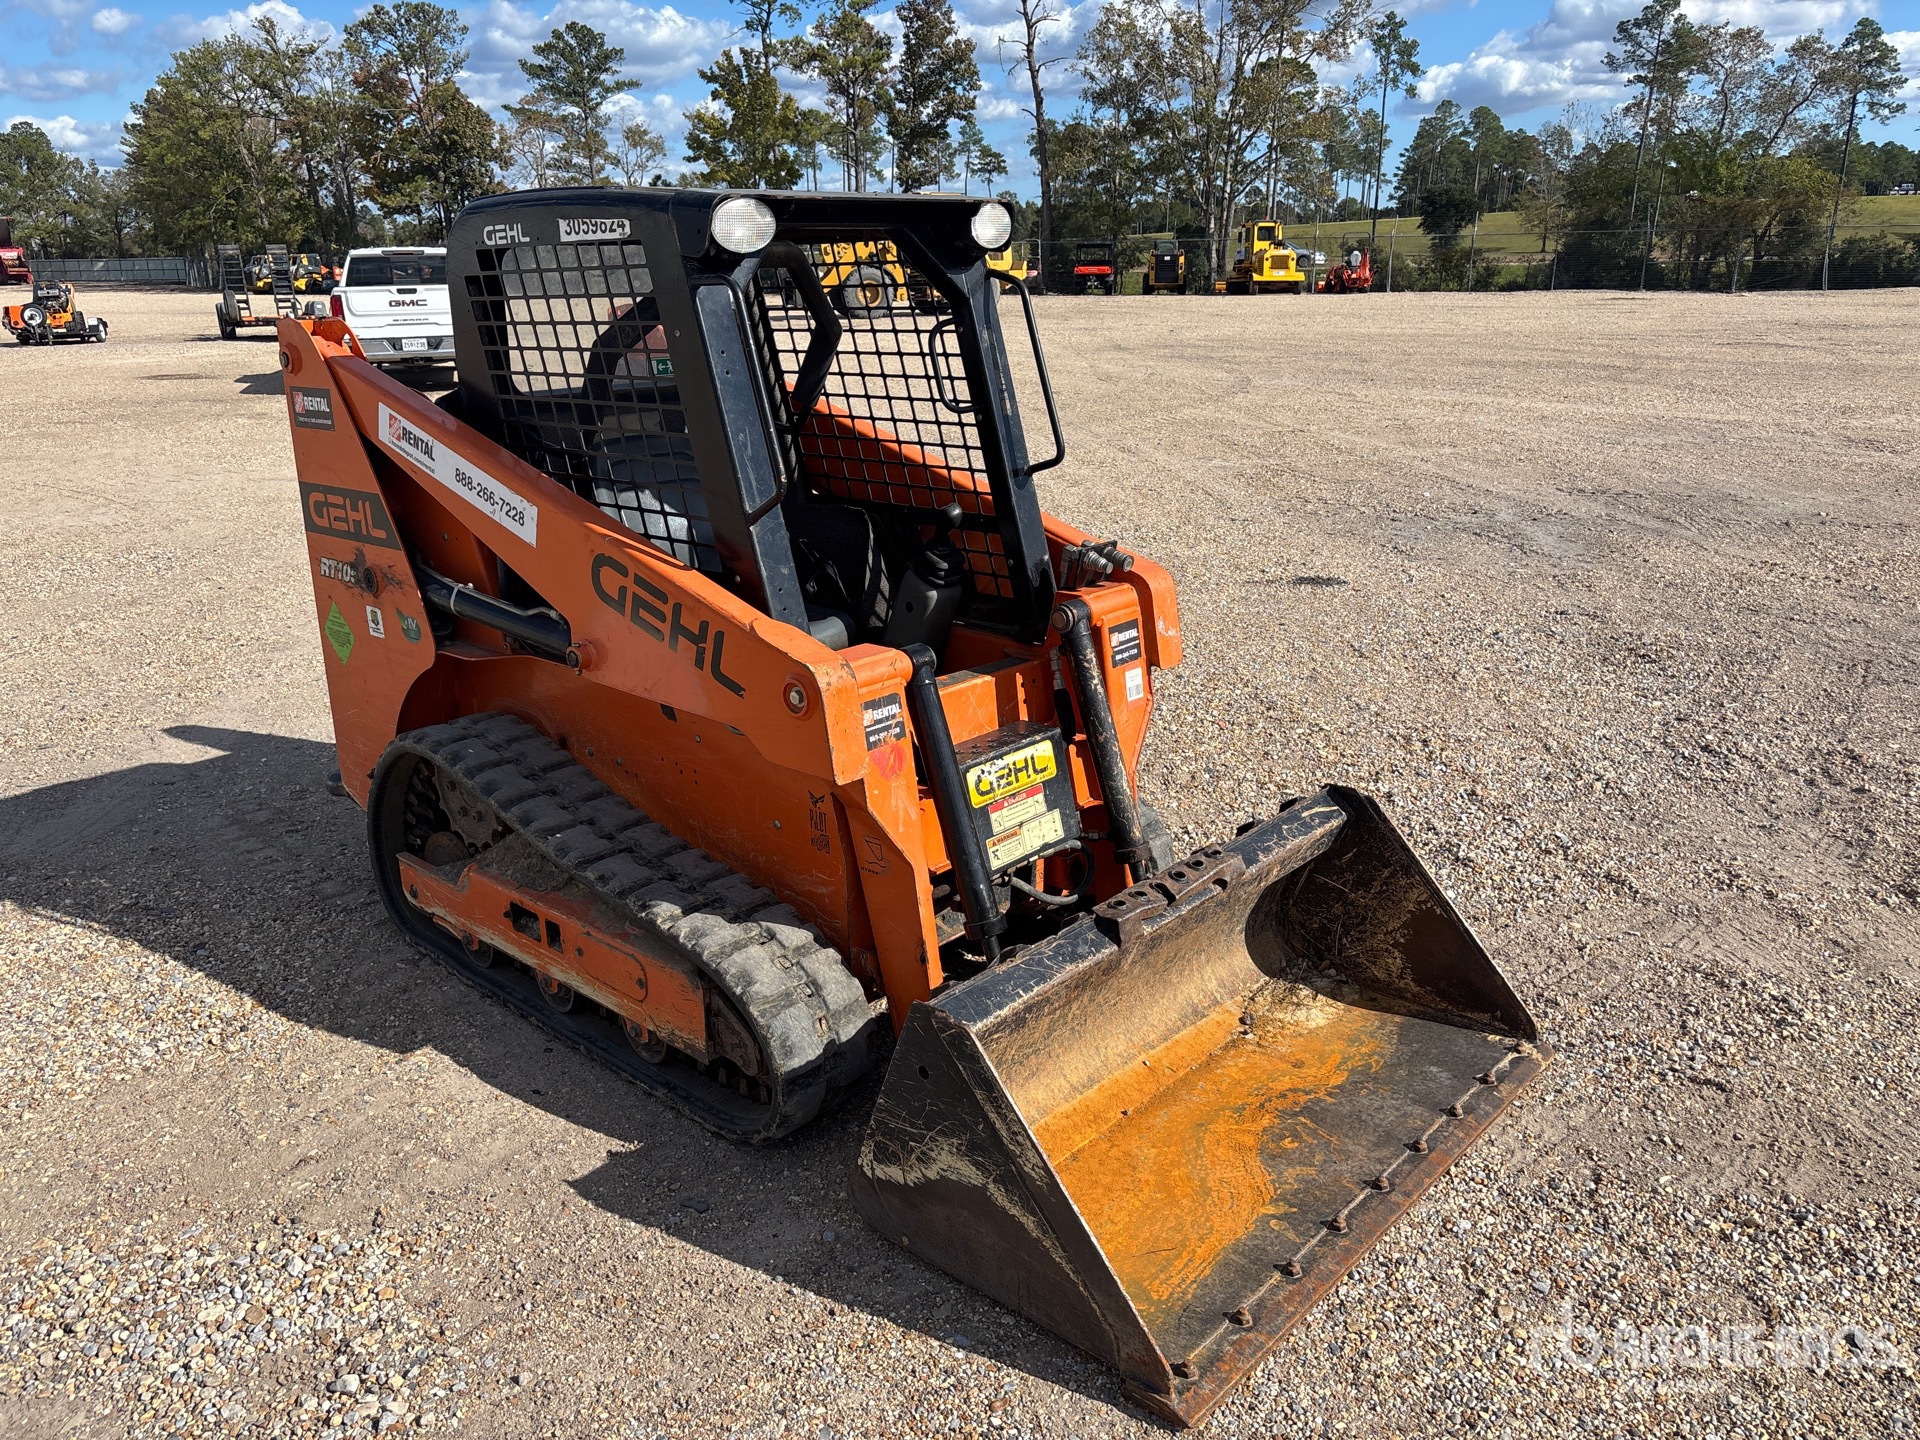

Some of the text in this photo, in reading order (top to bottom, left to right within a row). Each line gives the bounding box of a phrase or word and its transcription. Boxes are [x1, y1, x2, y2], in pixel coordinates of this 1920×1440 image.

[483, 222, 531, 246] GEHL
[388, 299, 428, 307] GMC
[303, 396, 330, 412] RENTAL
[402, 425, 436, 463] RENTAL
[454, 467, 526, 528] 888-266-7228
[308, 492, 387, 540] GEHL
[591, 553, 747, 699] GEHL
[1118, 628, 1139, 642] RENTAL
[873, 703, 902, 721] RENTAL
[974, 753, 1049, 797] GEHL
[996, 831, 1018, 844] WARNING
